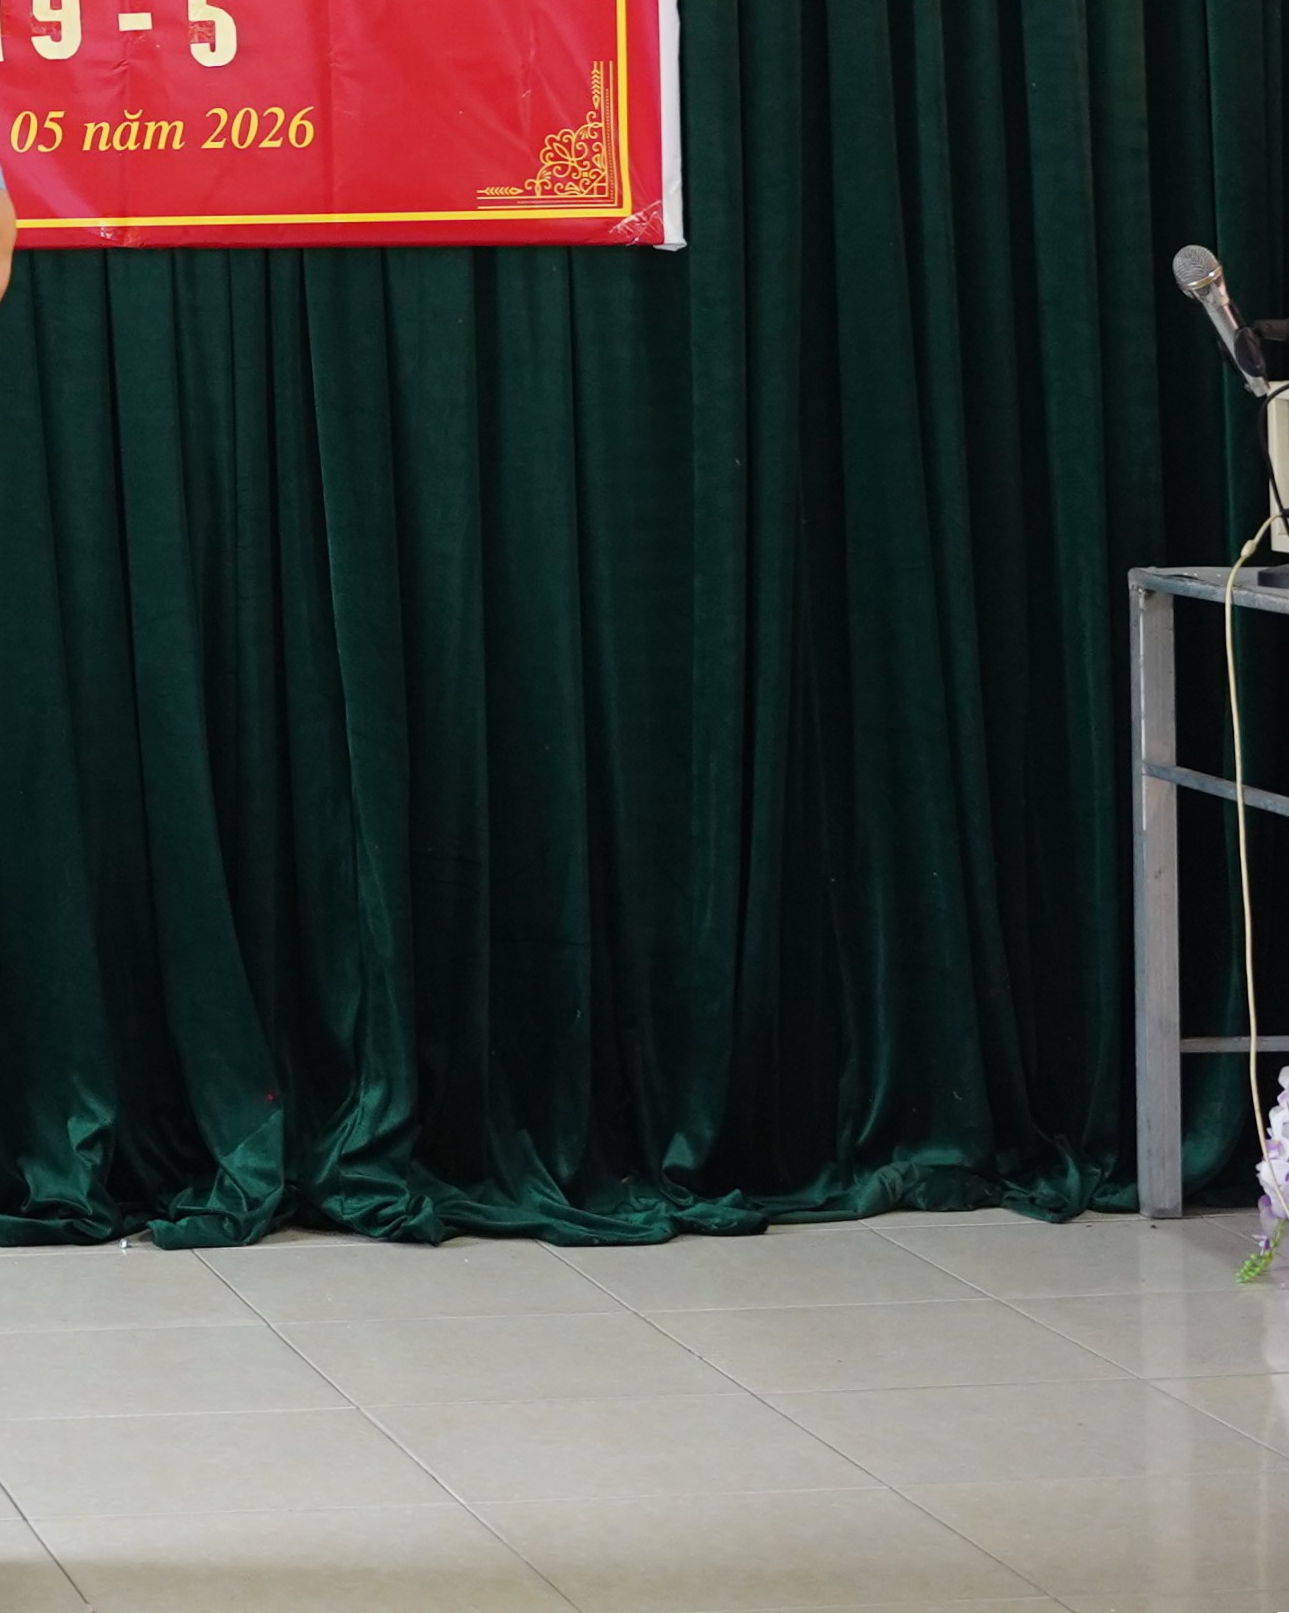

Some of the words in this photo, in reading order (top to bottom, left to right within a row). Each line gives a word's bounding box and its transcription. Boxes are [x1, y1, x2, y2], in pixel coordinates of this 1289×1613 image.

[10, 110, 66, 153] 05
[82, 109, 185, 152] năm
[201, 106, 315, 150] 2026
